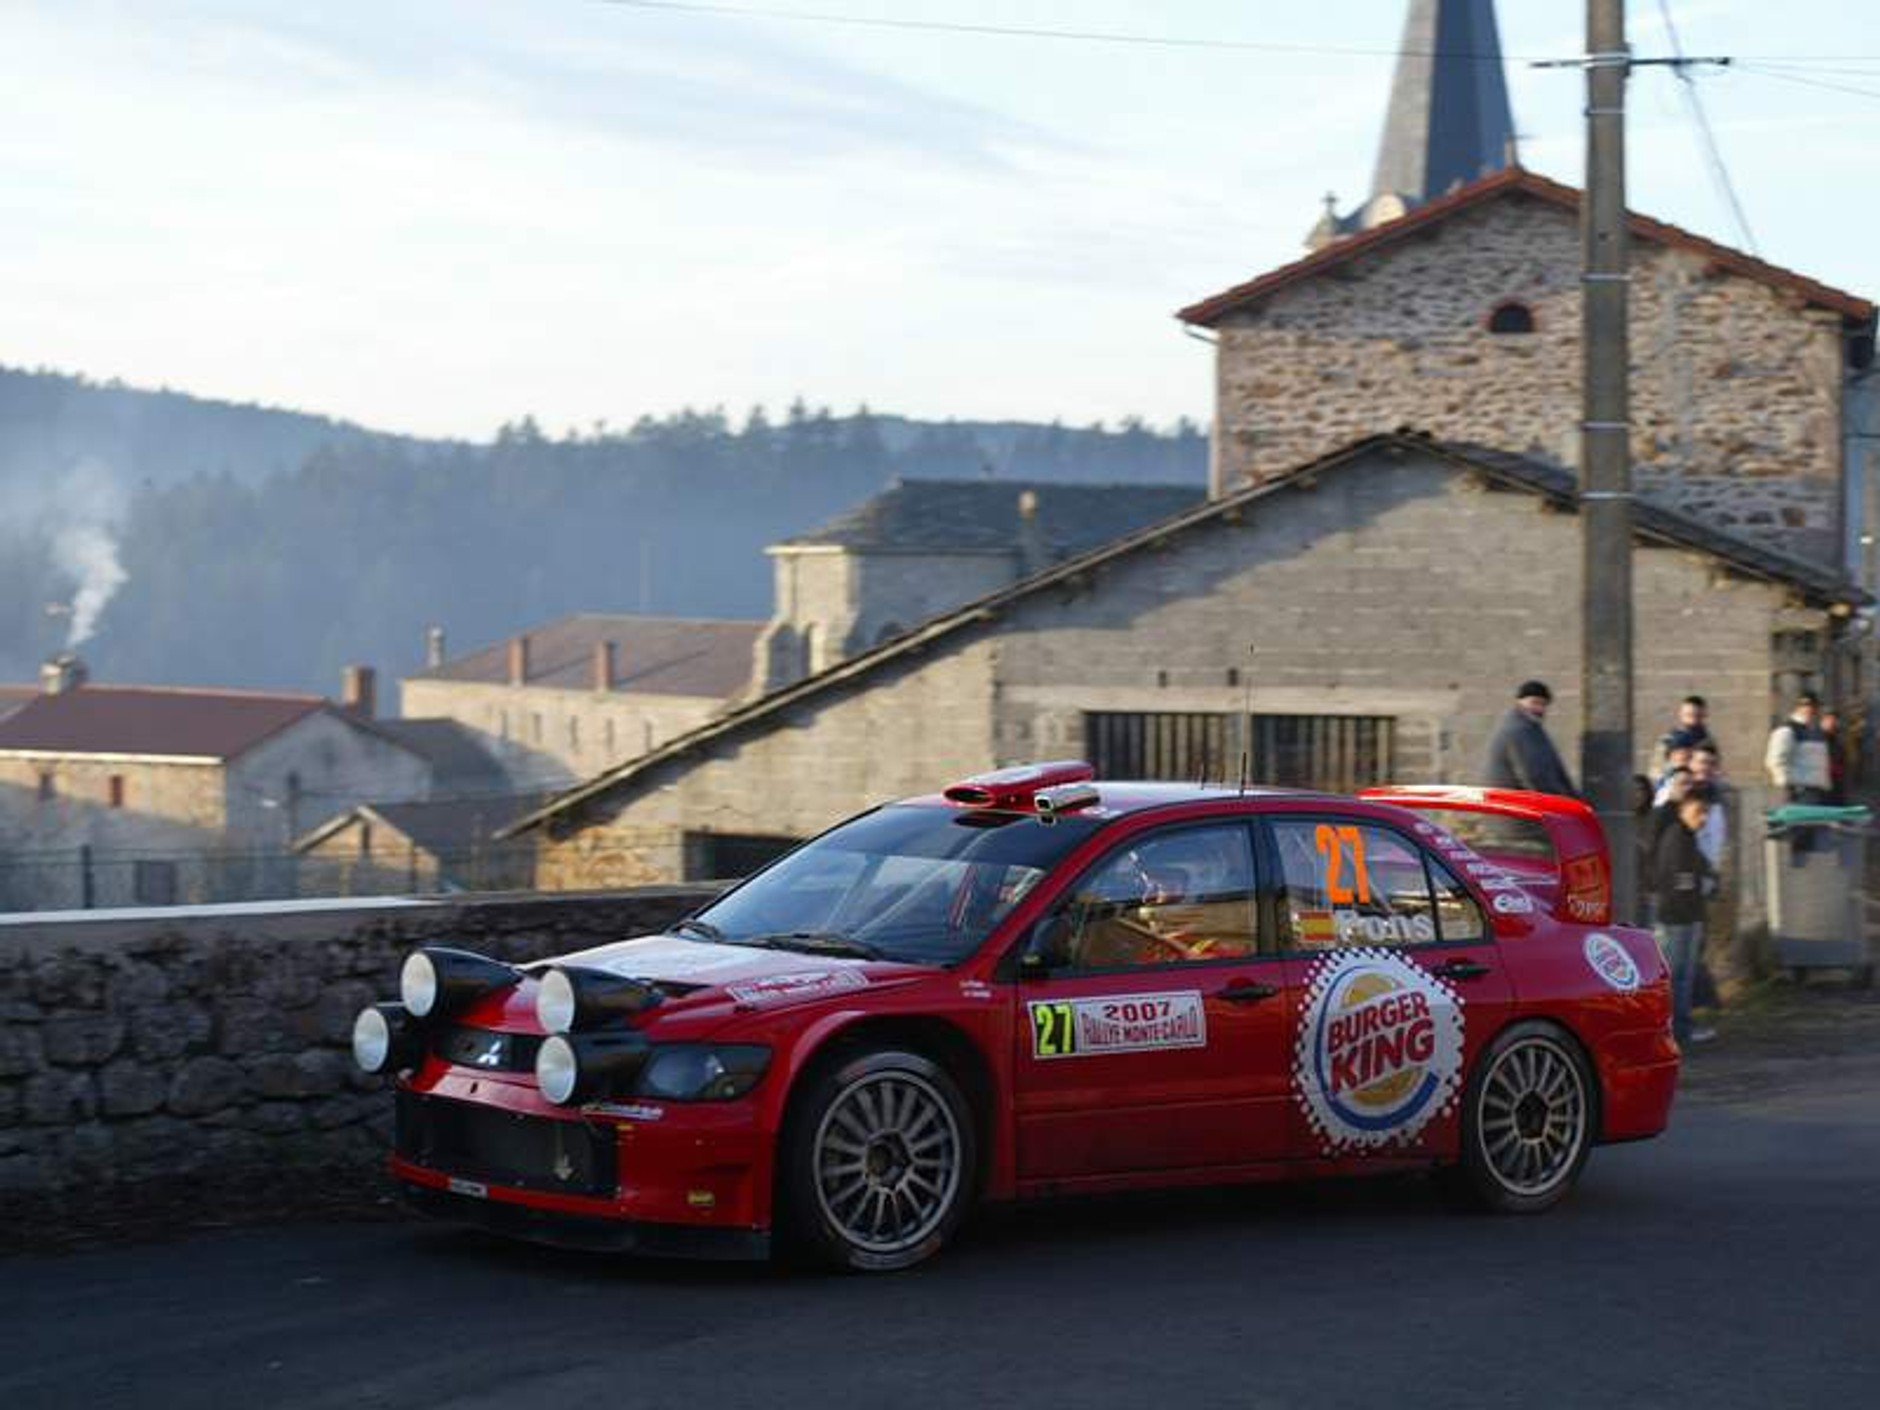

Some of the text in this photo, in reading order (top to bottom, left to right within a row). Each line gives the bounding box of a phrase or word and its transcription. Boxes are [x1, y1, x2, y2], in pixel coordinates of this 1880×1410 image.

[1315, 824, 1371, 904] 27
[1335, 909, 1434, 943] Pons
[1036, 1003, 1073, 1056] 27
[1103, 1001, 1169, 1022] 2007
[1328, 991, 1430, 1055] BURGER
[1331, 1018, 1434, 1094] KING
